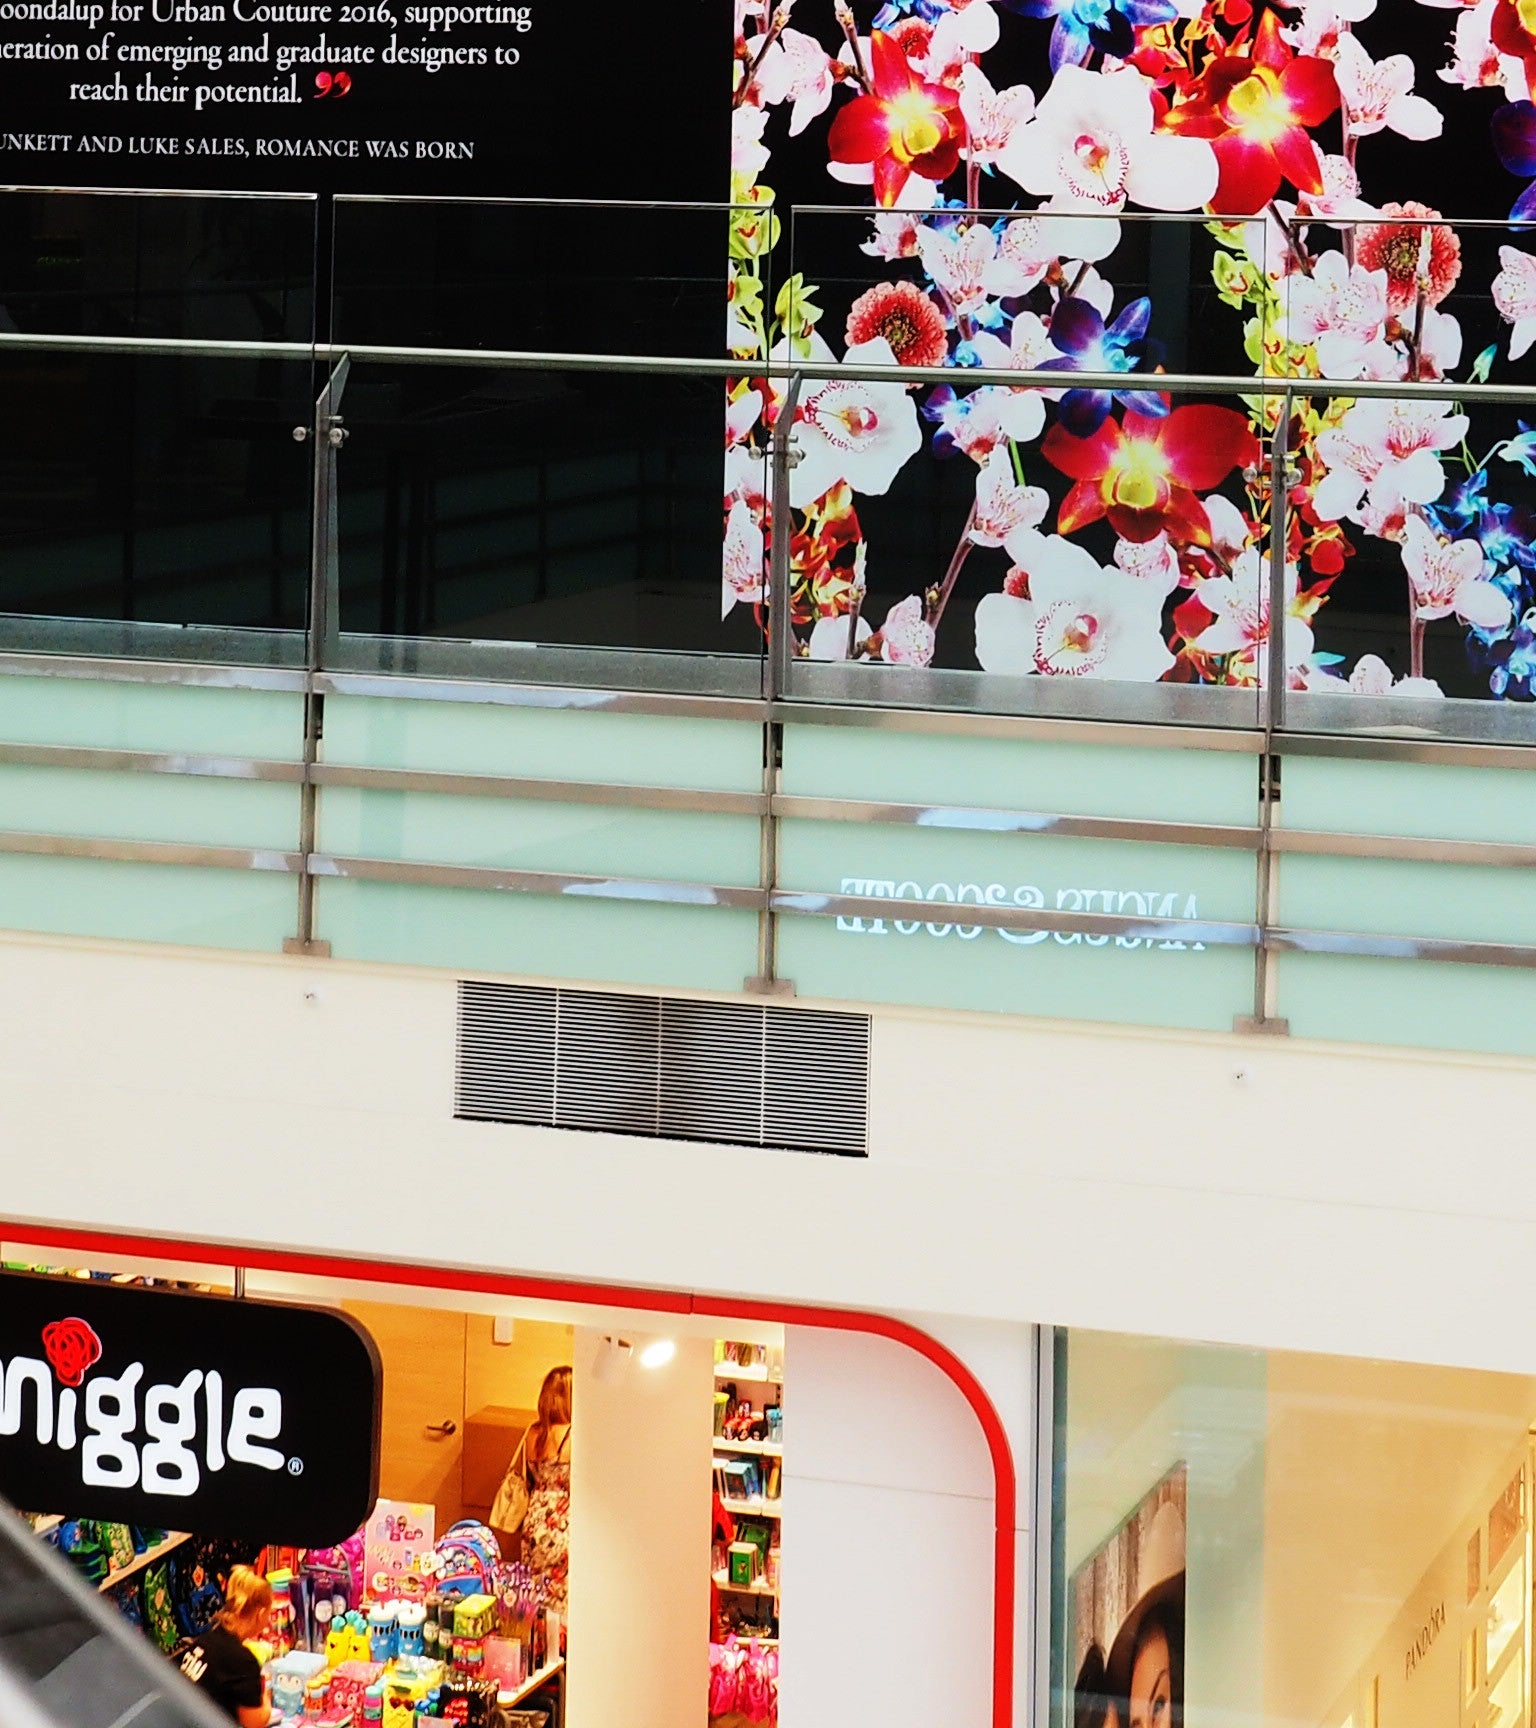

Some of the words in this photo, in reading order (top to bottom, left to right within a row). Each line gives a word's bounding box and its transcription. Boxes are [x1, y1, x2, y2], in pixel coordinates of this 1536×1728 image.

[86, 32, 115, 60] of
[118, 36, 222, 71] emerging
[228, 33, 269, 62] and
[276, 33, 375, 71] graduate
[382, 33, 487, 72] designers
[495, 47, 519, 65] to
[70, 71, 128, 100] reach
[136, 72, 189, 102] their
[77, 136, 122, 152] AND
[129, 137, 178, 154] LUKE
[185, 138, 249, 157] SALES,
[256, 139, 359, 157] ROMANCE
[366, 141, 408, 157] WAS
[416, 142, 474, 159] BORN
